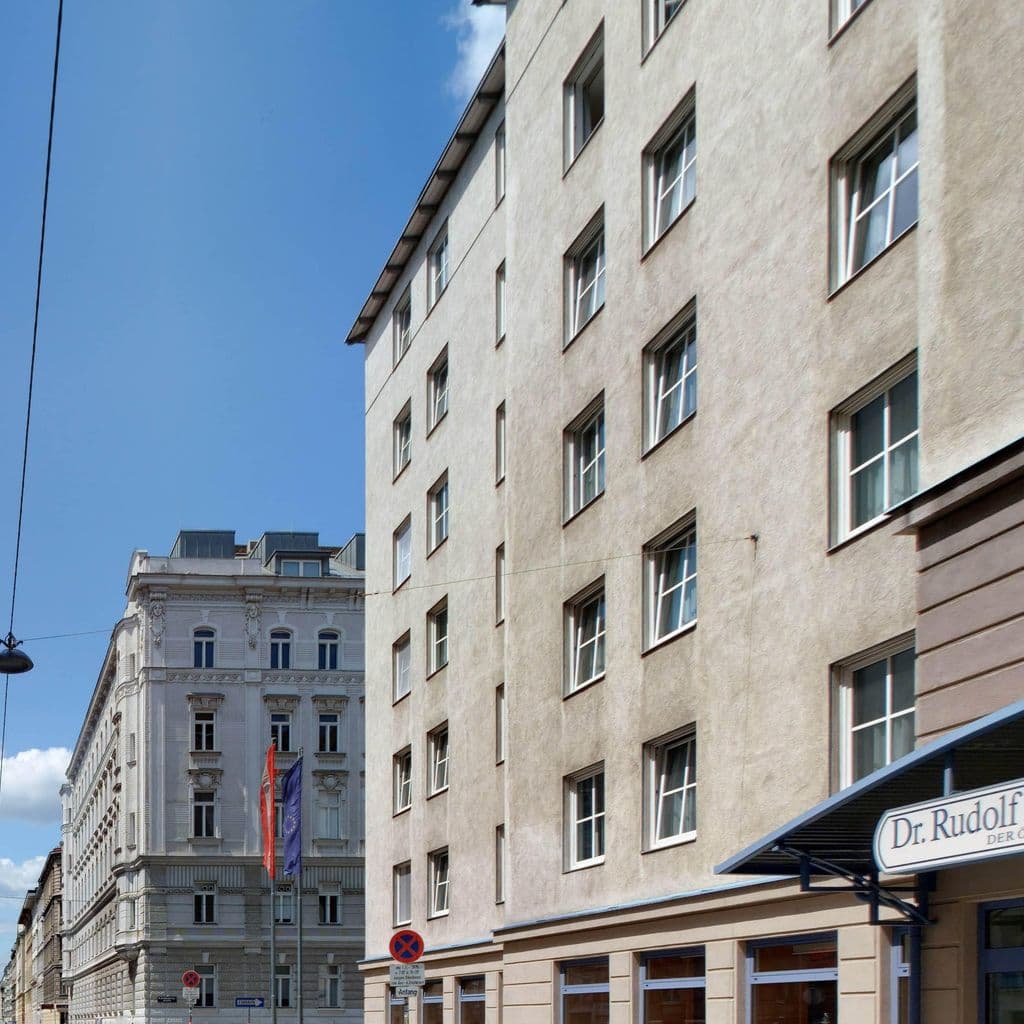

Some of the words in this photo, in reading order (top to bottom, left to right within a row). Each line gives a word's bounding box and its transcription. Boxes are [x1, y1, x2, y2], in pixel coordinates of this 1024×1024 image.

[891, 817, 926, 850] Dr.
[931, 791, 1024, 841] Rudolf
[987, 831, 1017, 846] DER
